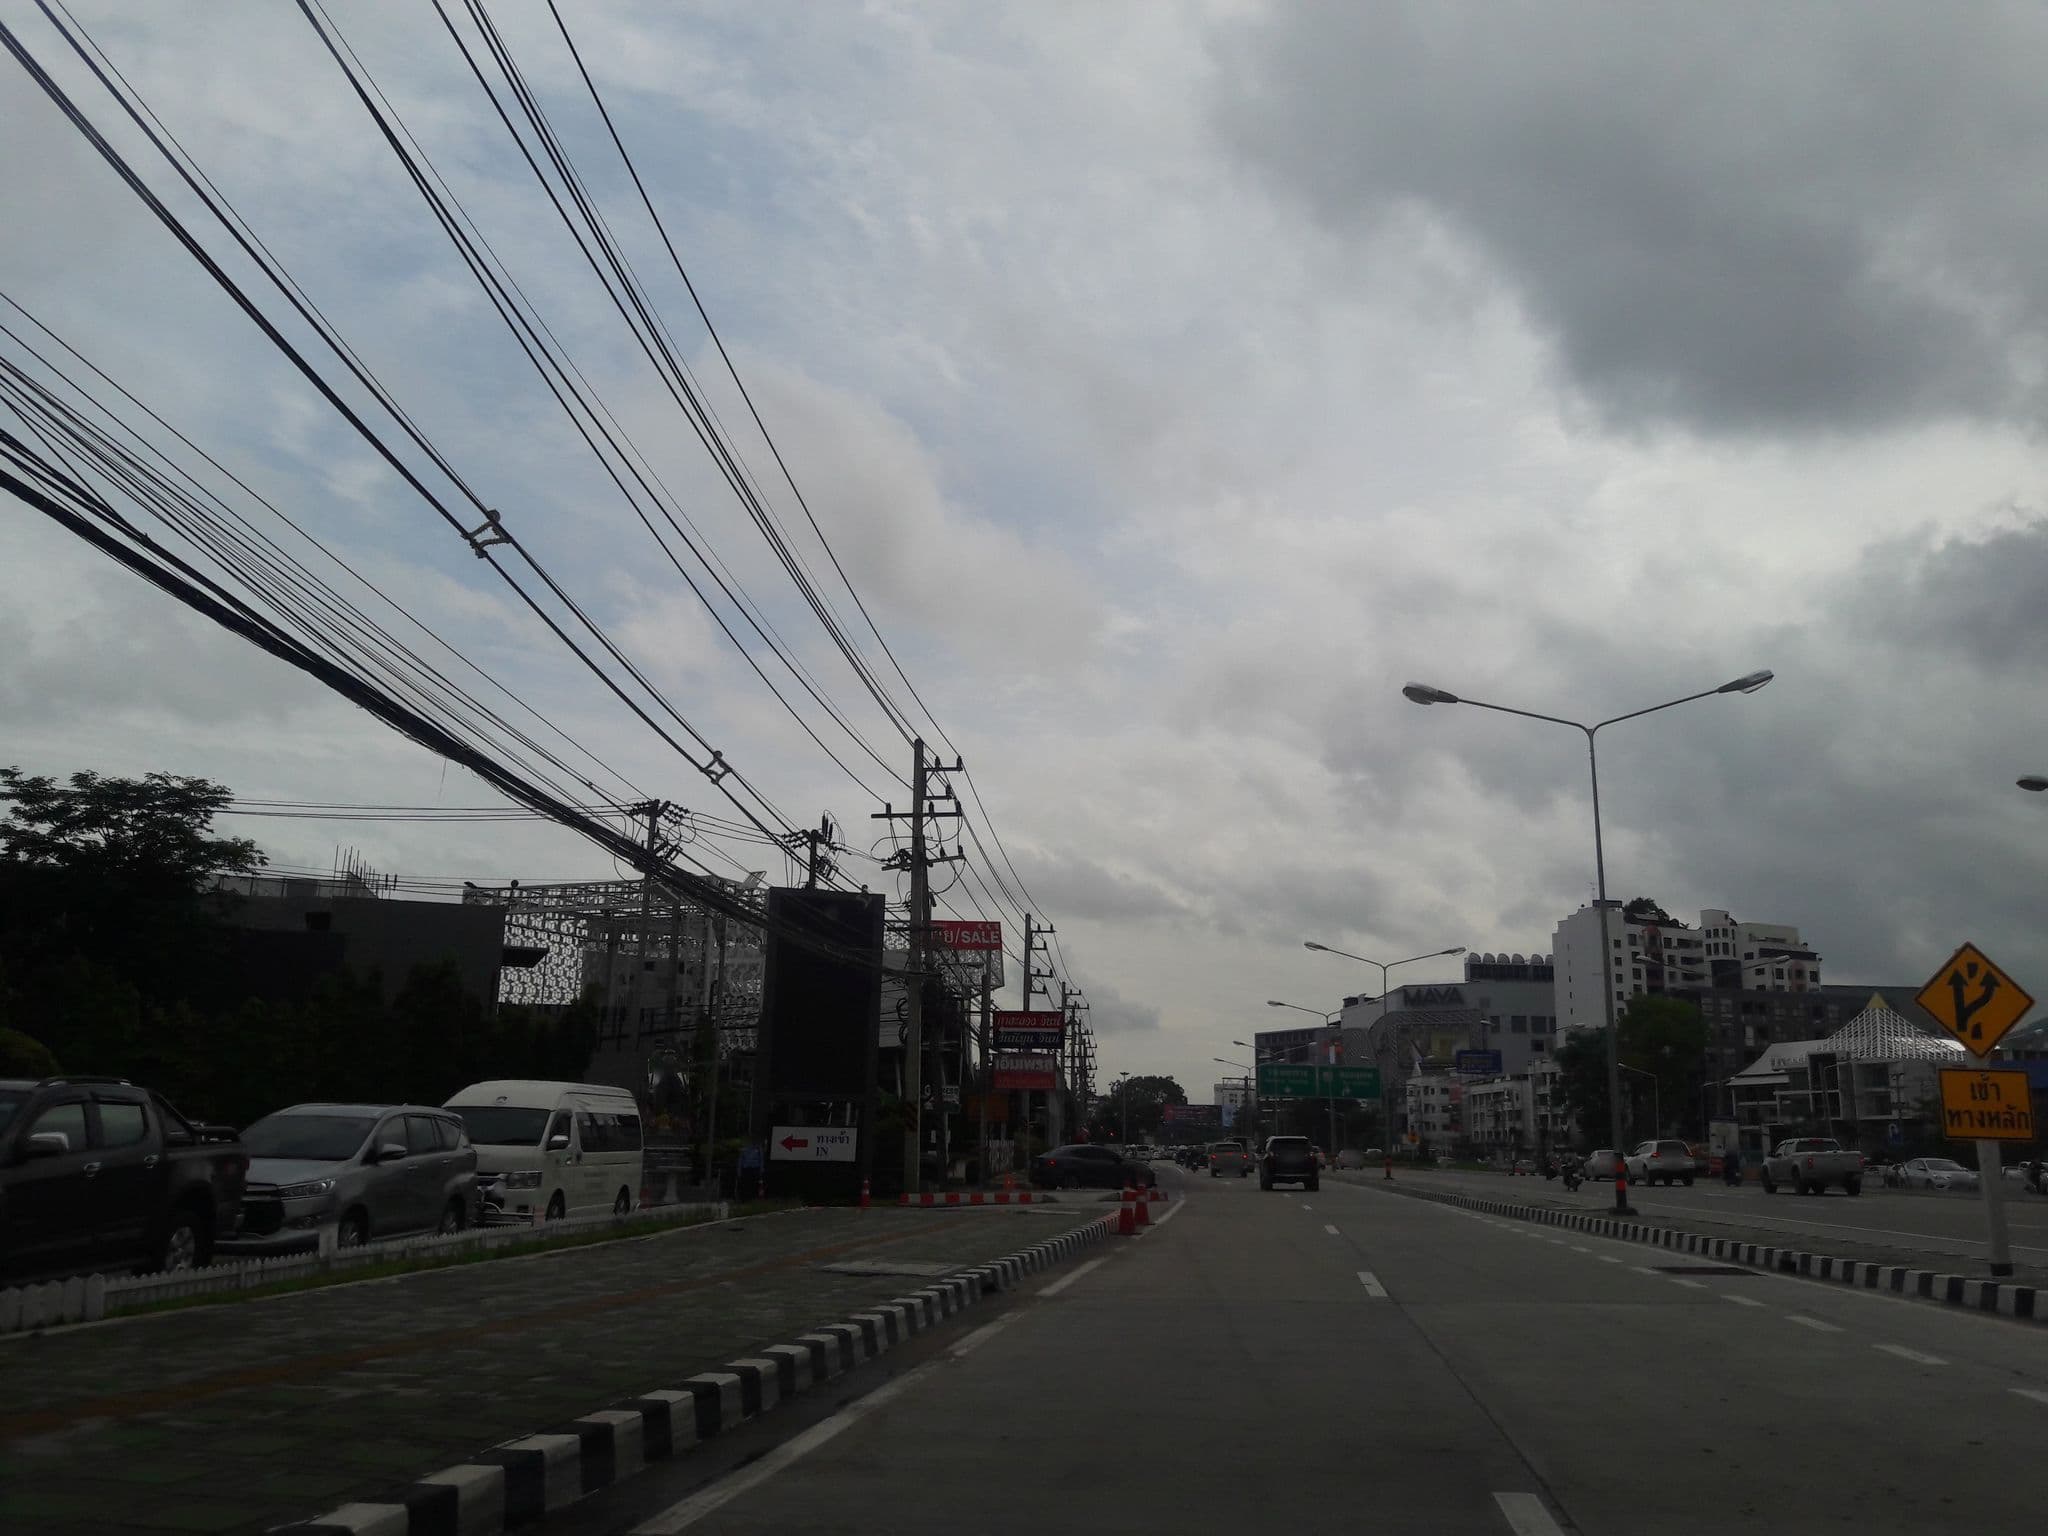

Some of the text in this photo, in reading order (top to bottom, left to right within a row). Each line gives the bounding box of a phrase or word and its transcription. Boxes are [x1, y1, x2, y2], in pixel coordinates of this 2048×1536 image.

[1403, 986, 1464, 1007] MAYA
[1970, 1073, 2001, 1101] เข้า
[1947, 1104, 2030, 1130] ทางหลัก
[816, 1146, 829, 1156] IN
